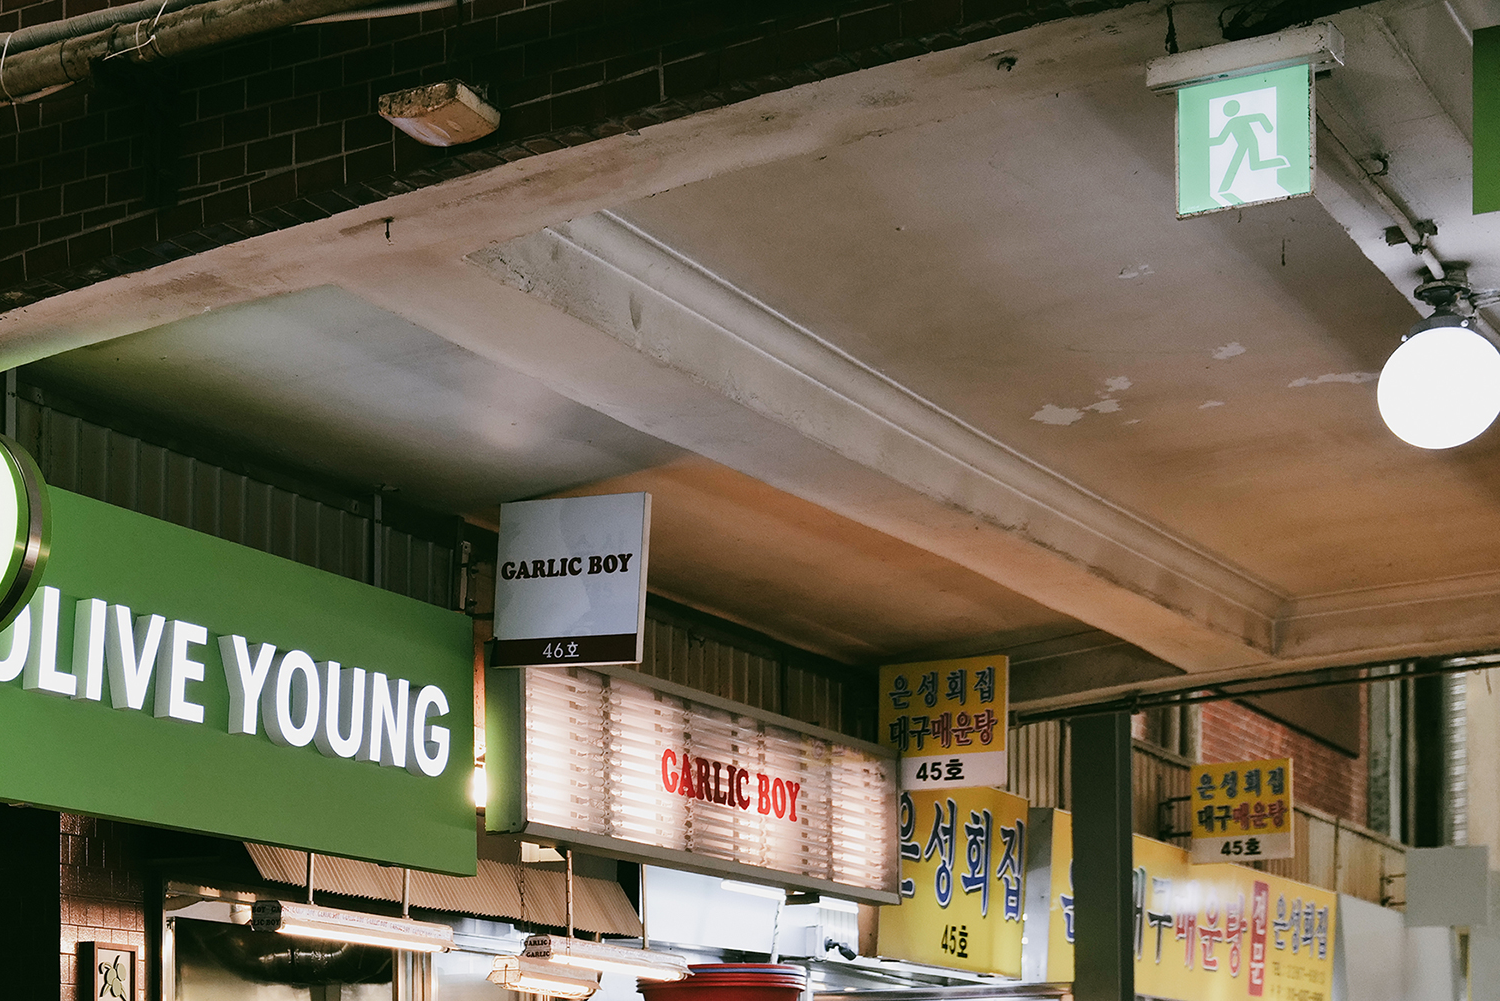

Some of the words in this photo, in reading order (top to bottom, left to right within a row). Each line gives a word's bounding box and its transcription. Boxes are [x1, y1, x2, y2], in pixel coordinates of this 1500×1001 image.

[501, 558, 583, 580] GARLIC
[587, 553, 633, 575] BOY
[542, 640, 580, 660] 46호
[888, 666, 995, 709] 은성회집
[218, 634, 451, 778] YOUNG
[888, 708, 998, 752] 대구매운탕
[662, 748, 750, 811] GARLIC
[757, 773, 801, 823] BOY
[916, 758, 965, 781] 45호
[1196, 766, 1285, 800] 은성회집
[1196, 799, 1288, 832] 대구매운탕
[900, 790, 1026, 922] 은성회집
[1220, 838, 1262, 856] 45호
[941, 924, 968, 958] 45호
